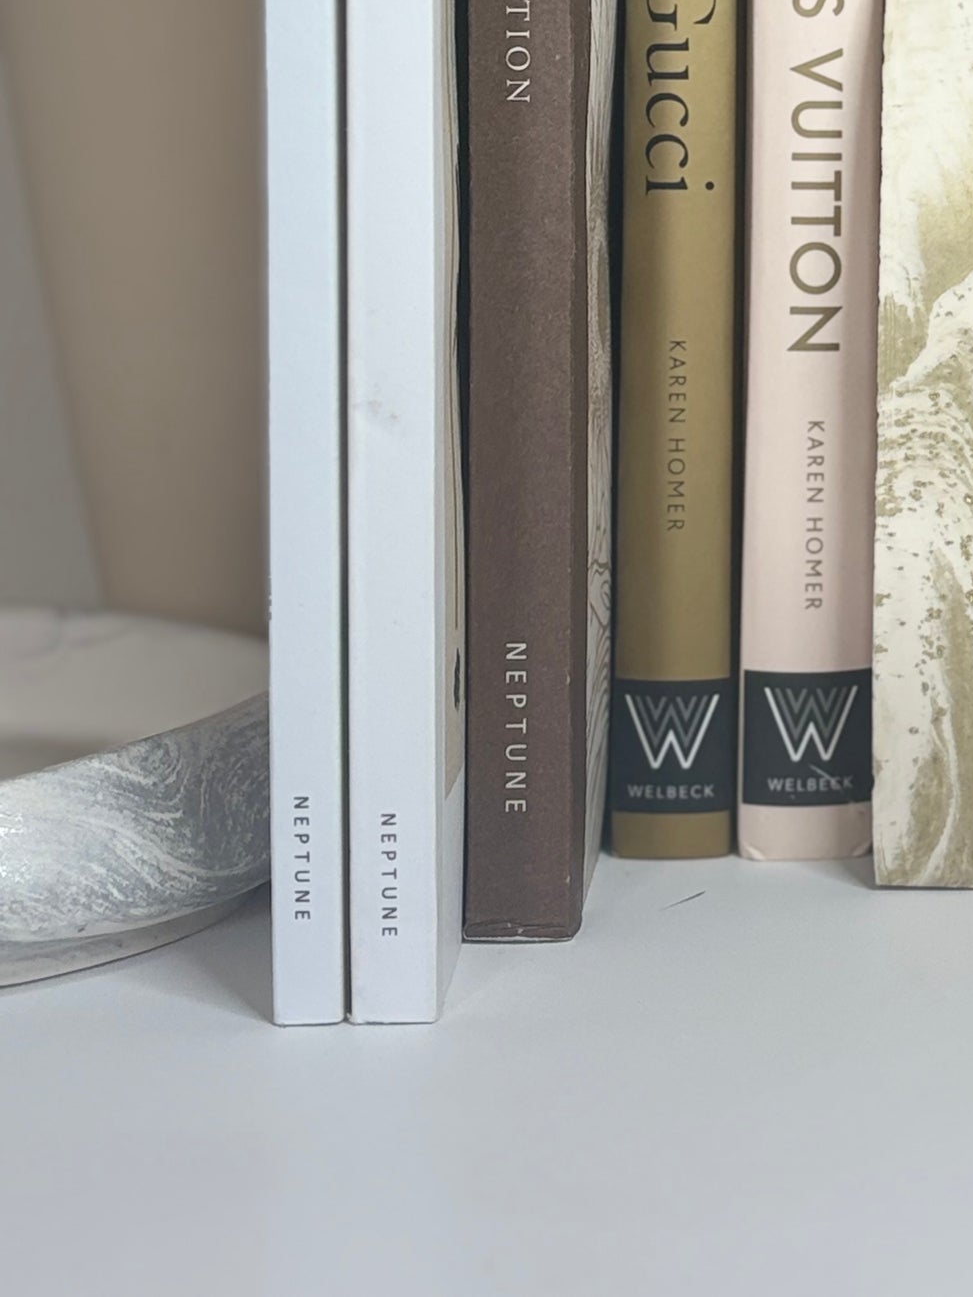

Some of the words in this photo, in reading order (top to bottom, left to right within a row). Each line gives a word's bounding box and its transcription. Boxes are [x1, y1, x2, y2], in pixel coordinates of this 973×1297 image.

[787, 47, 845, 354] VUITTON
[667, 339, 687, 425] KAREN
[665, 437, 686, 533] HOMER
[806, 419, 826, 504] KAREN
[804, 516, 824, 611] HOMER
[505, 642, 527, 814] NEPTUNE
[627, 784, 715, 800] WELBECK
[767, 776, 853, 793] WELBECK
[293, 796, 311, 921] NEPTUNE
[380, 813, 399, 938] NEPTUNE
